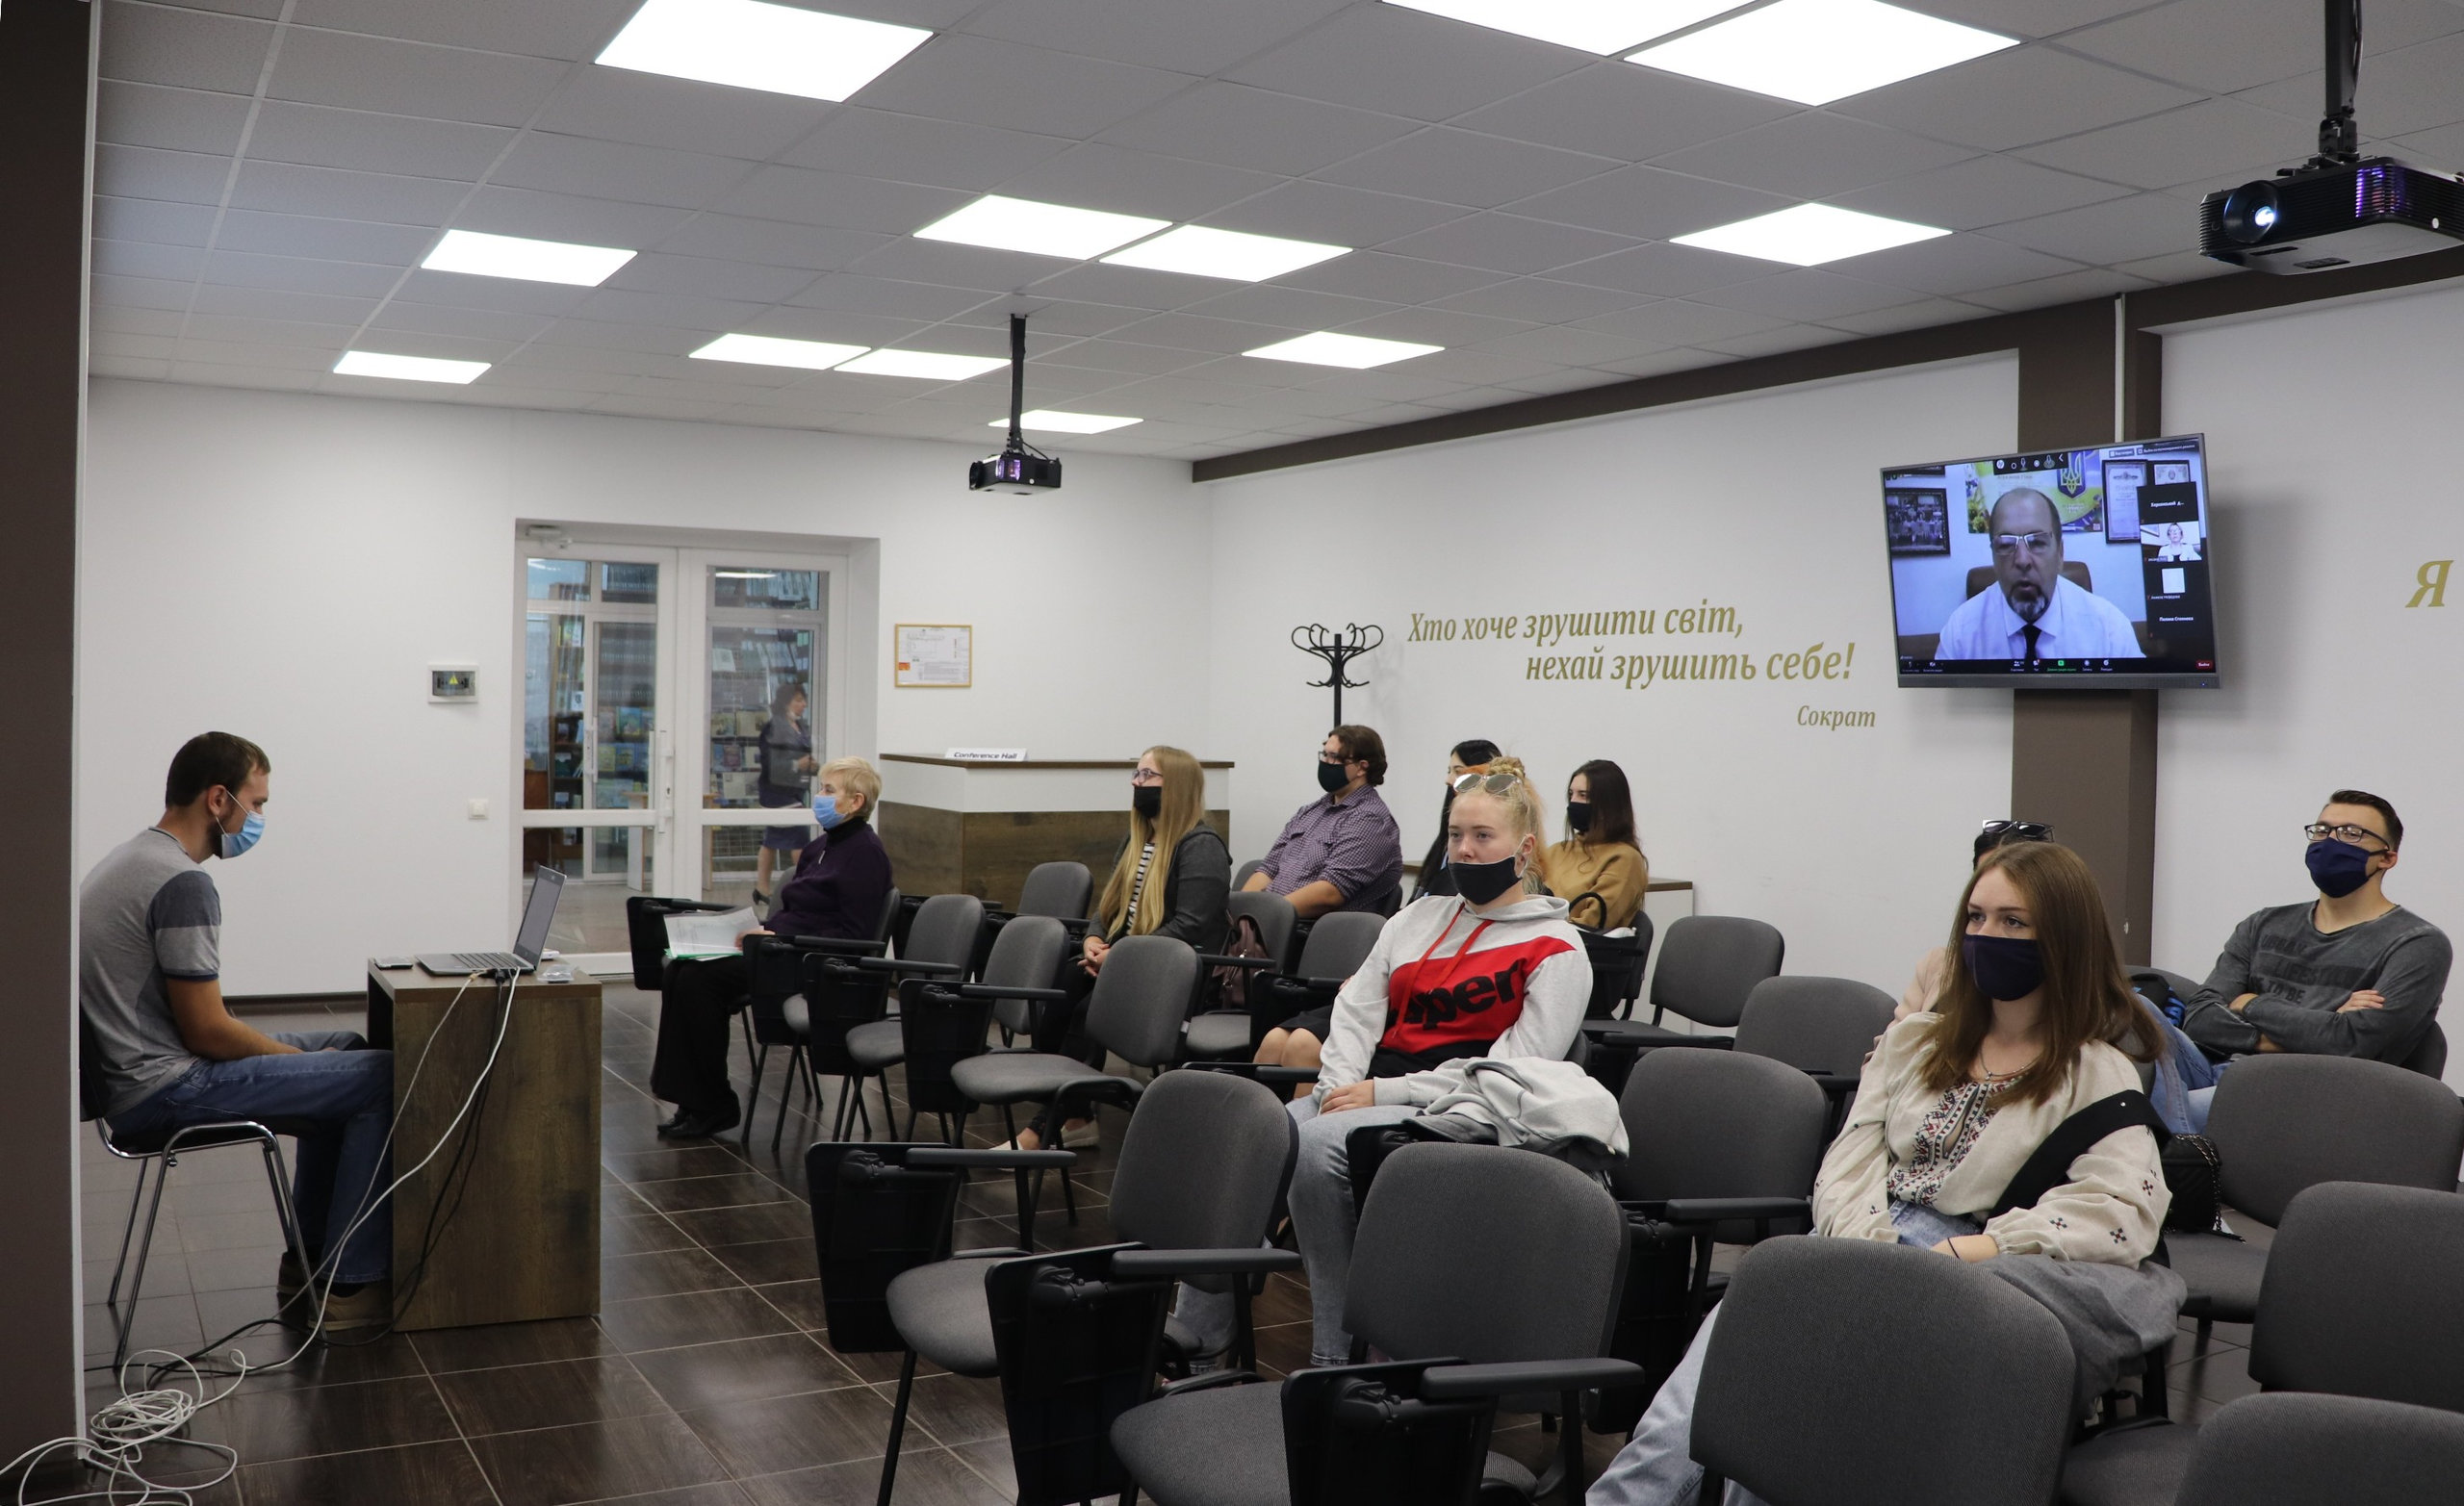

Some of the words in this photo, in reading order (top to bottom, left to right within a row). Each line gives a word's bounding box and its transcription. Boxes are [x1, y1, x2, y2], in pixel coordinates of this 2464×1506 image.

[2404, 559, 2454, 608] Я
[1407, 612, 1456, 643] Хто
[1462, 616, 1517, 641] хоче
[1522, 610, 1656, 648] зрушити
[1663, 599, 1743, 639] світ,
[1526, 647, 1604, 681] нехай
[1610, 654, 1757, 690] зрушить
[1765, 642, 1856, 680] себе!
[1797, 704, 1877, 732] Сократ
